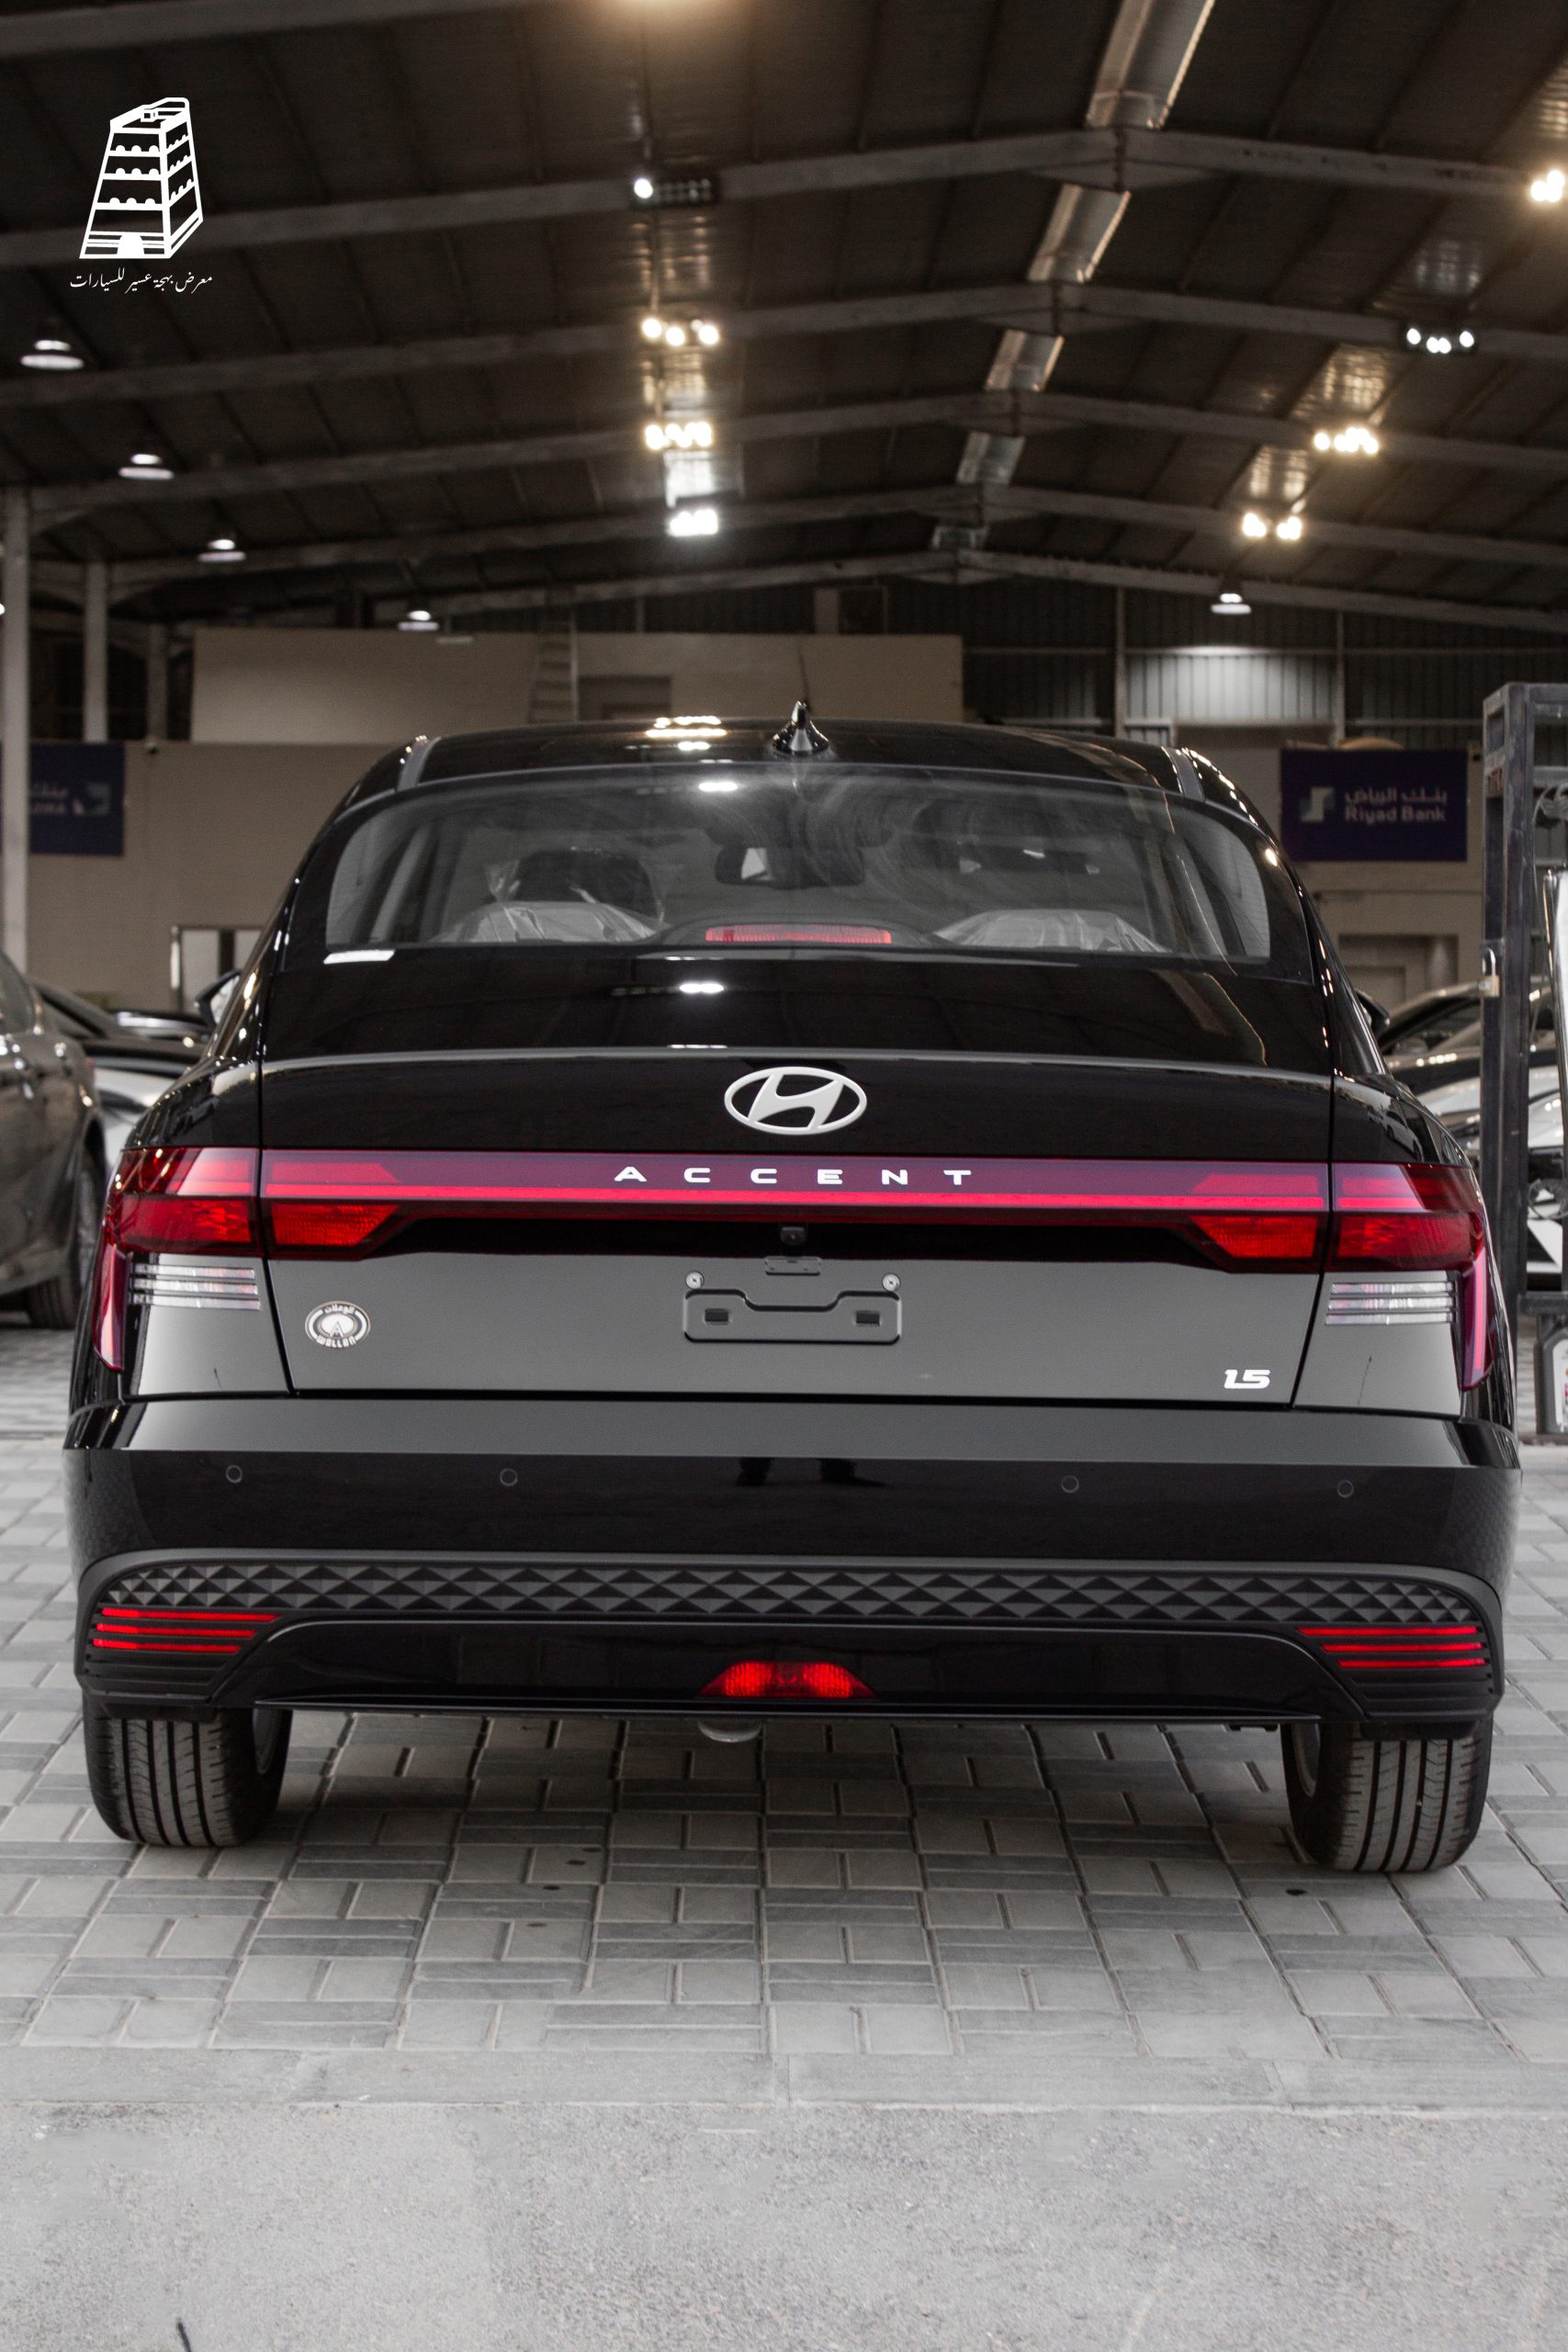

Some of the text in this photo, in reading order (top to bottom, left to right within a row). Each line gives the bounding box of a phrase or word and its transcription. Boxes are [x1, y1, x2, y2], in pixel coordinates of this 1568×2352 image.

[1345, 805, 1447, 825] Riyad Bank
[614, 1166, 973, 1186] ACCENT
